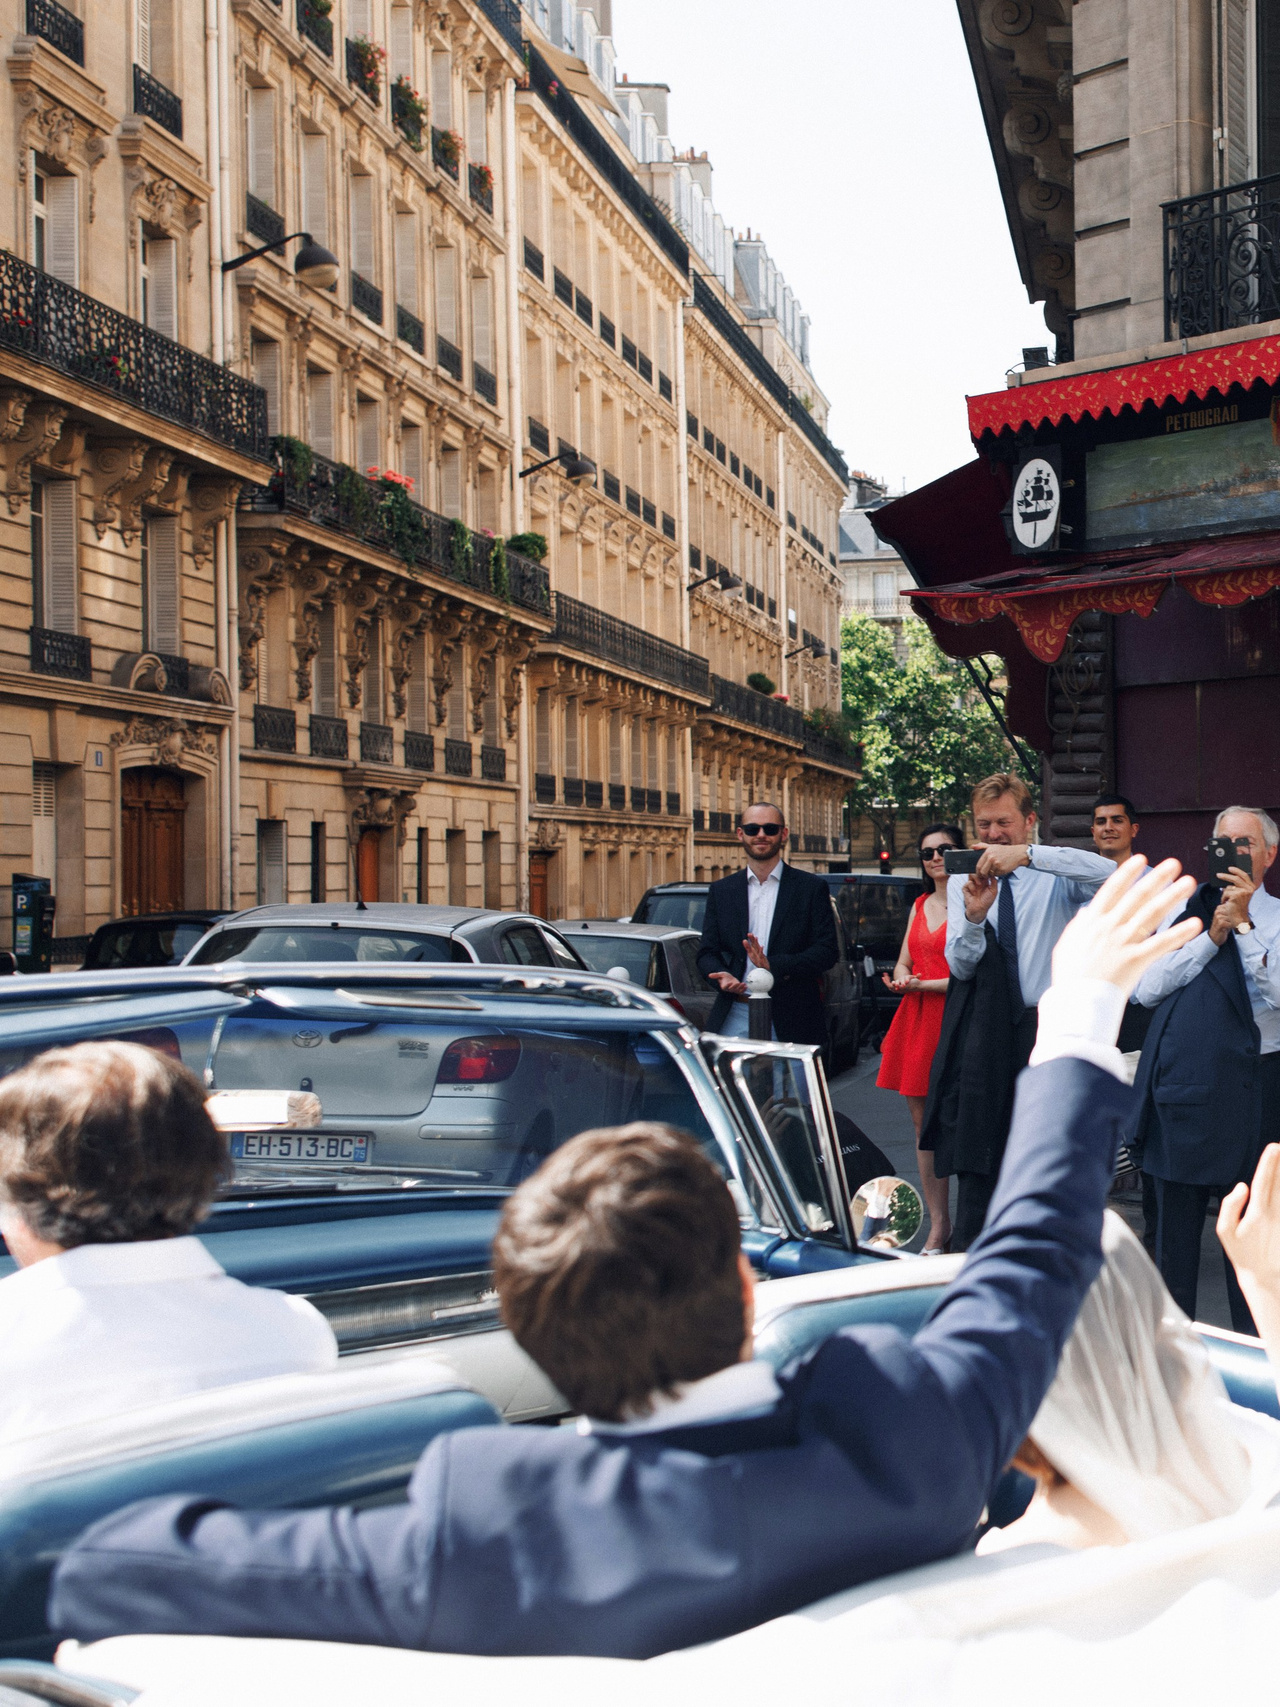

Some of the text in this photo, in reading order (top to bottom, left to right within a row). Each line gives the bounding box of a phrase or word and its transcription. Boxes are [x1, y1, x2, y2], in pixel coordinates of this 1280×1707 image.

[1165, 404, 1238, 432] PETROGRAD
[244, 1135, 353, 1158] EH-513-BC
[354, 1149, 366, 1159] 75
